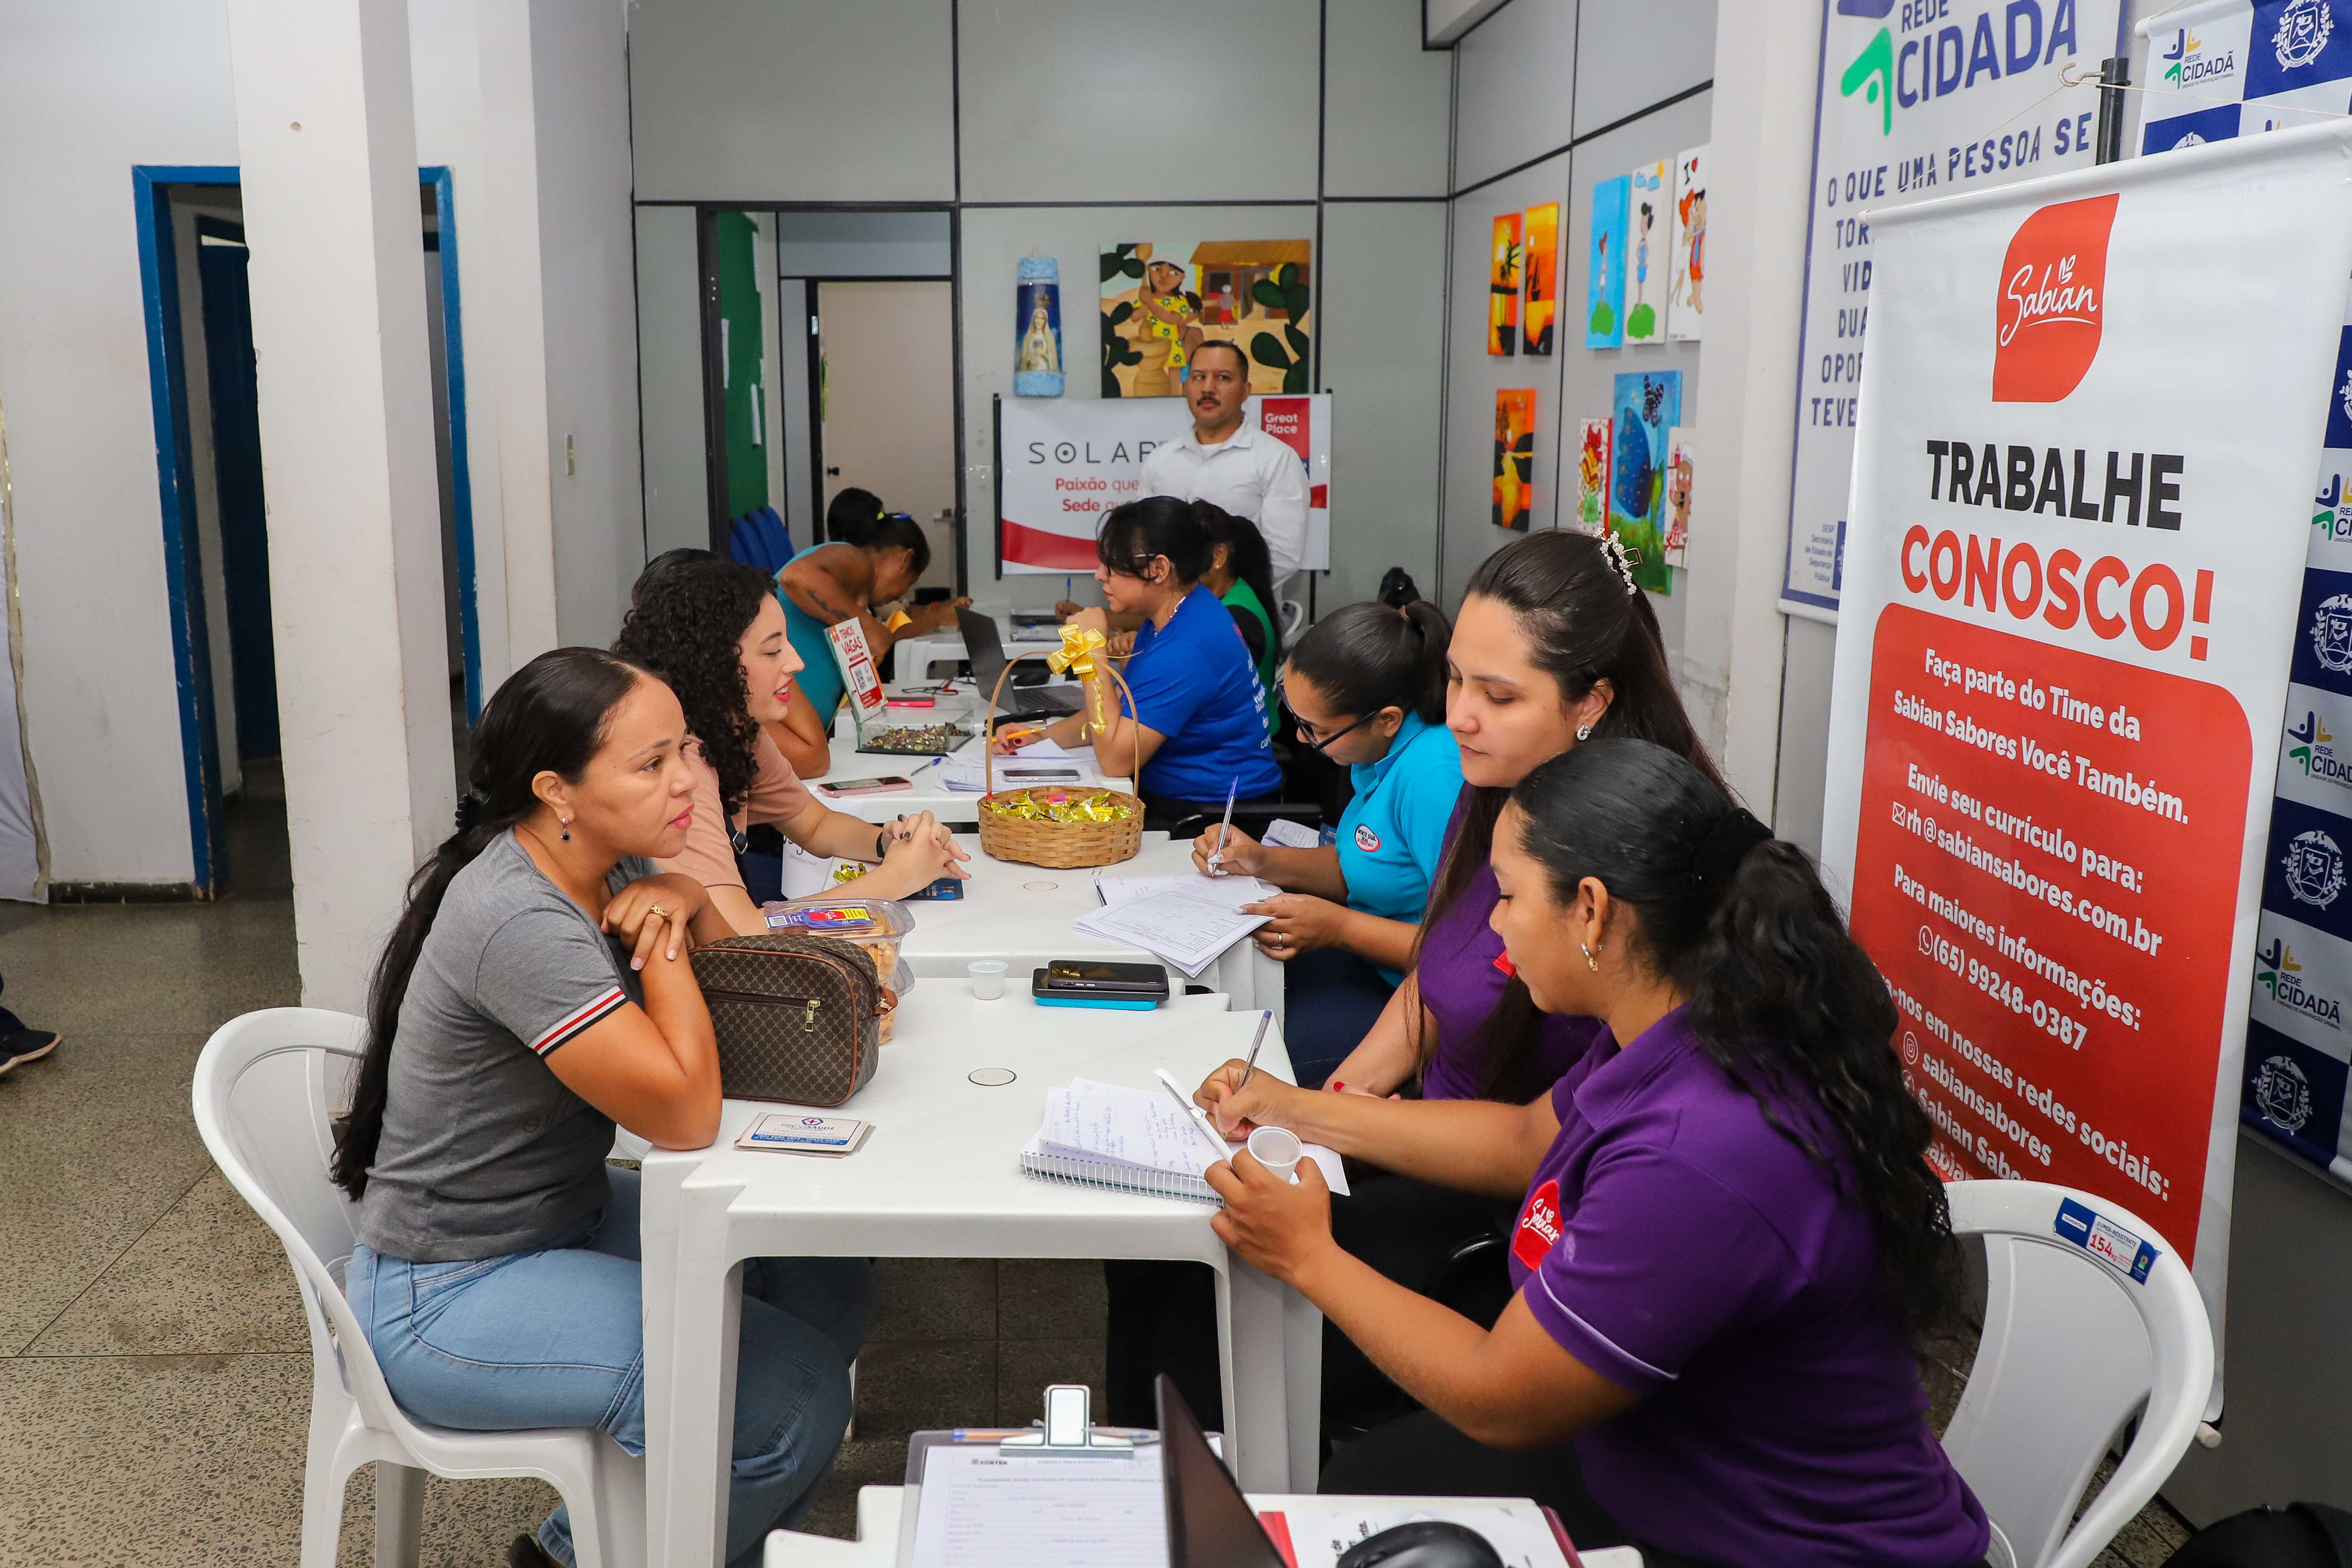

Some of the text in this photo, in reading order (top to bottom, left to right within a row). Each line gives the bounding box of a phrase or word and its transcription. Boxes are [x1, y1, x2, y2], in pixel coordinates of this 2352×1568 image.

[2182, 50, 2234, 82] CIDADÃ
[2184, 52, 2201, 64] REDE
[1828, 112, 2093, 207] O QUE UMA PESSOA SE
[2000, 254, 2098, 347] Sabian
[1265, 412, 1298, 423] Great
[1265, 423, 1298, 435] Place
[1055, 477, 1141, 494] Paixão que
[1062, 498, 1101, 512] Sede
[1926, 439, 2185, 531] TRABALHE
[1900, 523, 2215, 663] CONOSCO!
[841, 636, 863, 655] VAGAS
[1925, 647, 2141, 742] Faça parte do Time da
[1893, 689, 2189, 825] Sabian Sabores Você Também.
[2315, 745, 2334, 757] REDE
[1908, 762, 2144, 894] Envie seu currículo para:
[1894, 863, 2141, 1031] Para maiores informações:
[2280, 972, 2302, 987] REDE
[1933, 934, 2088, 1051] (65) 99248-0387
[2277, 982, 2341, 1024] CIDADÃ
[1918, 1088, 1973, 1153] Sabian
[1922, 1053, 2052, 1166] sabiansabores
[1925, 1011, 1949, 1043] em
[1952, 1030, 2014, 1089] nossas
[2017, 1076, 2077, 1134] redes
[2079, 1121, 2170, 1202] sociais:
[2097, 1221, 2137, 1247] SUPER-RESISTENTE
